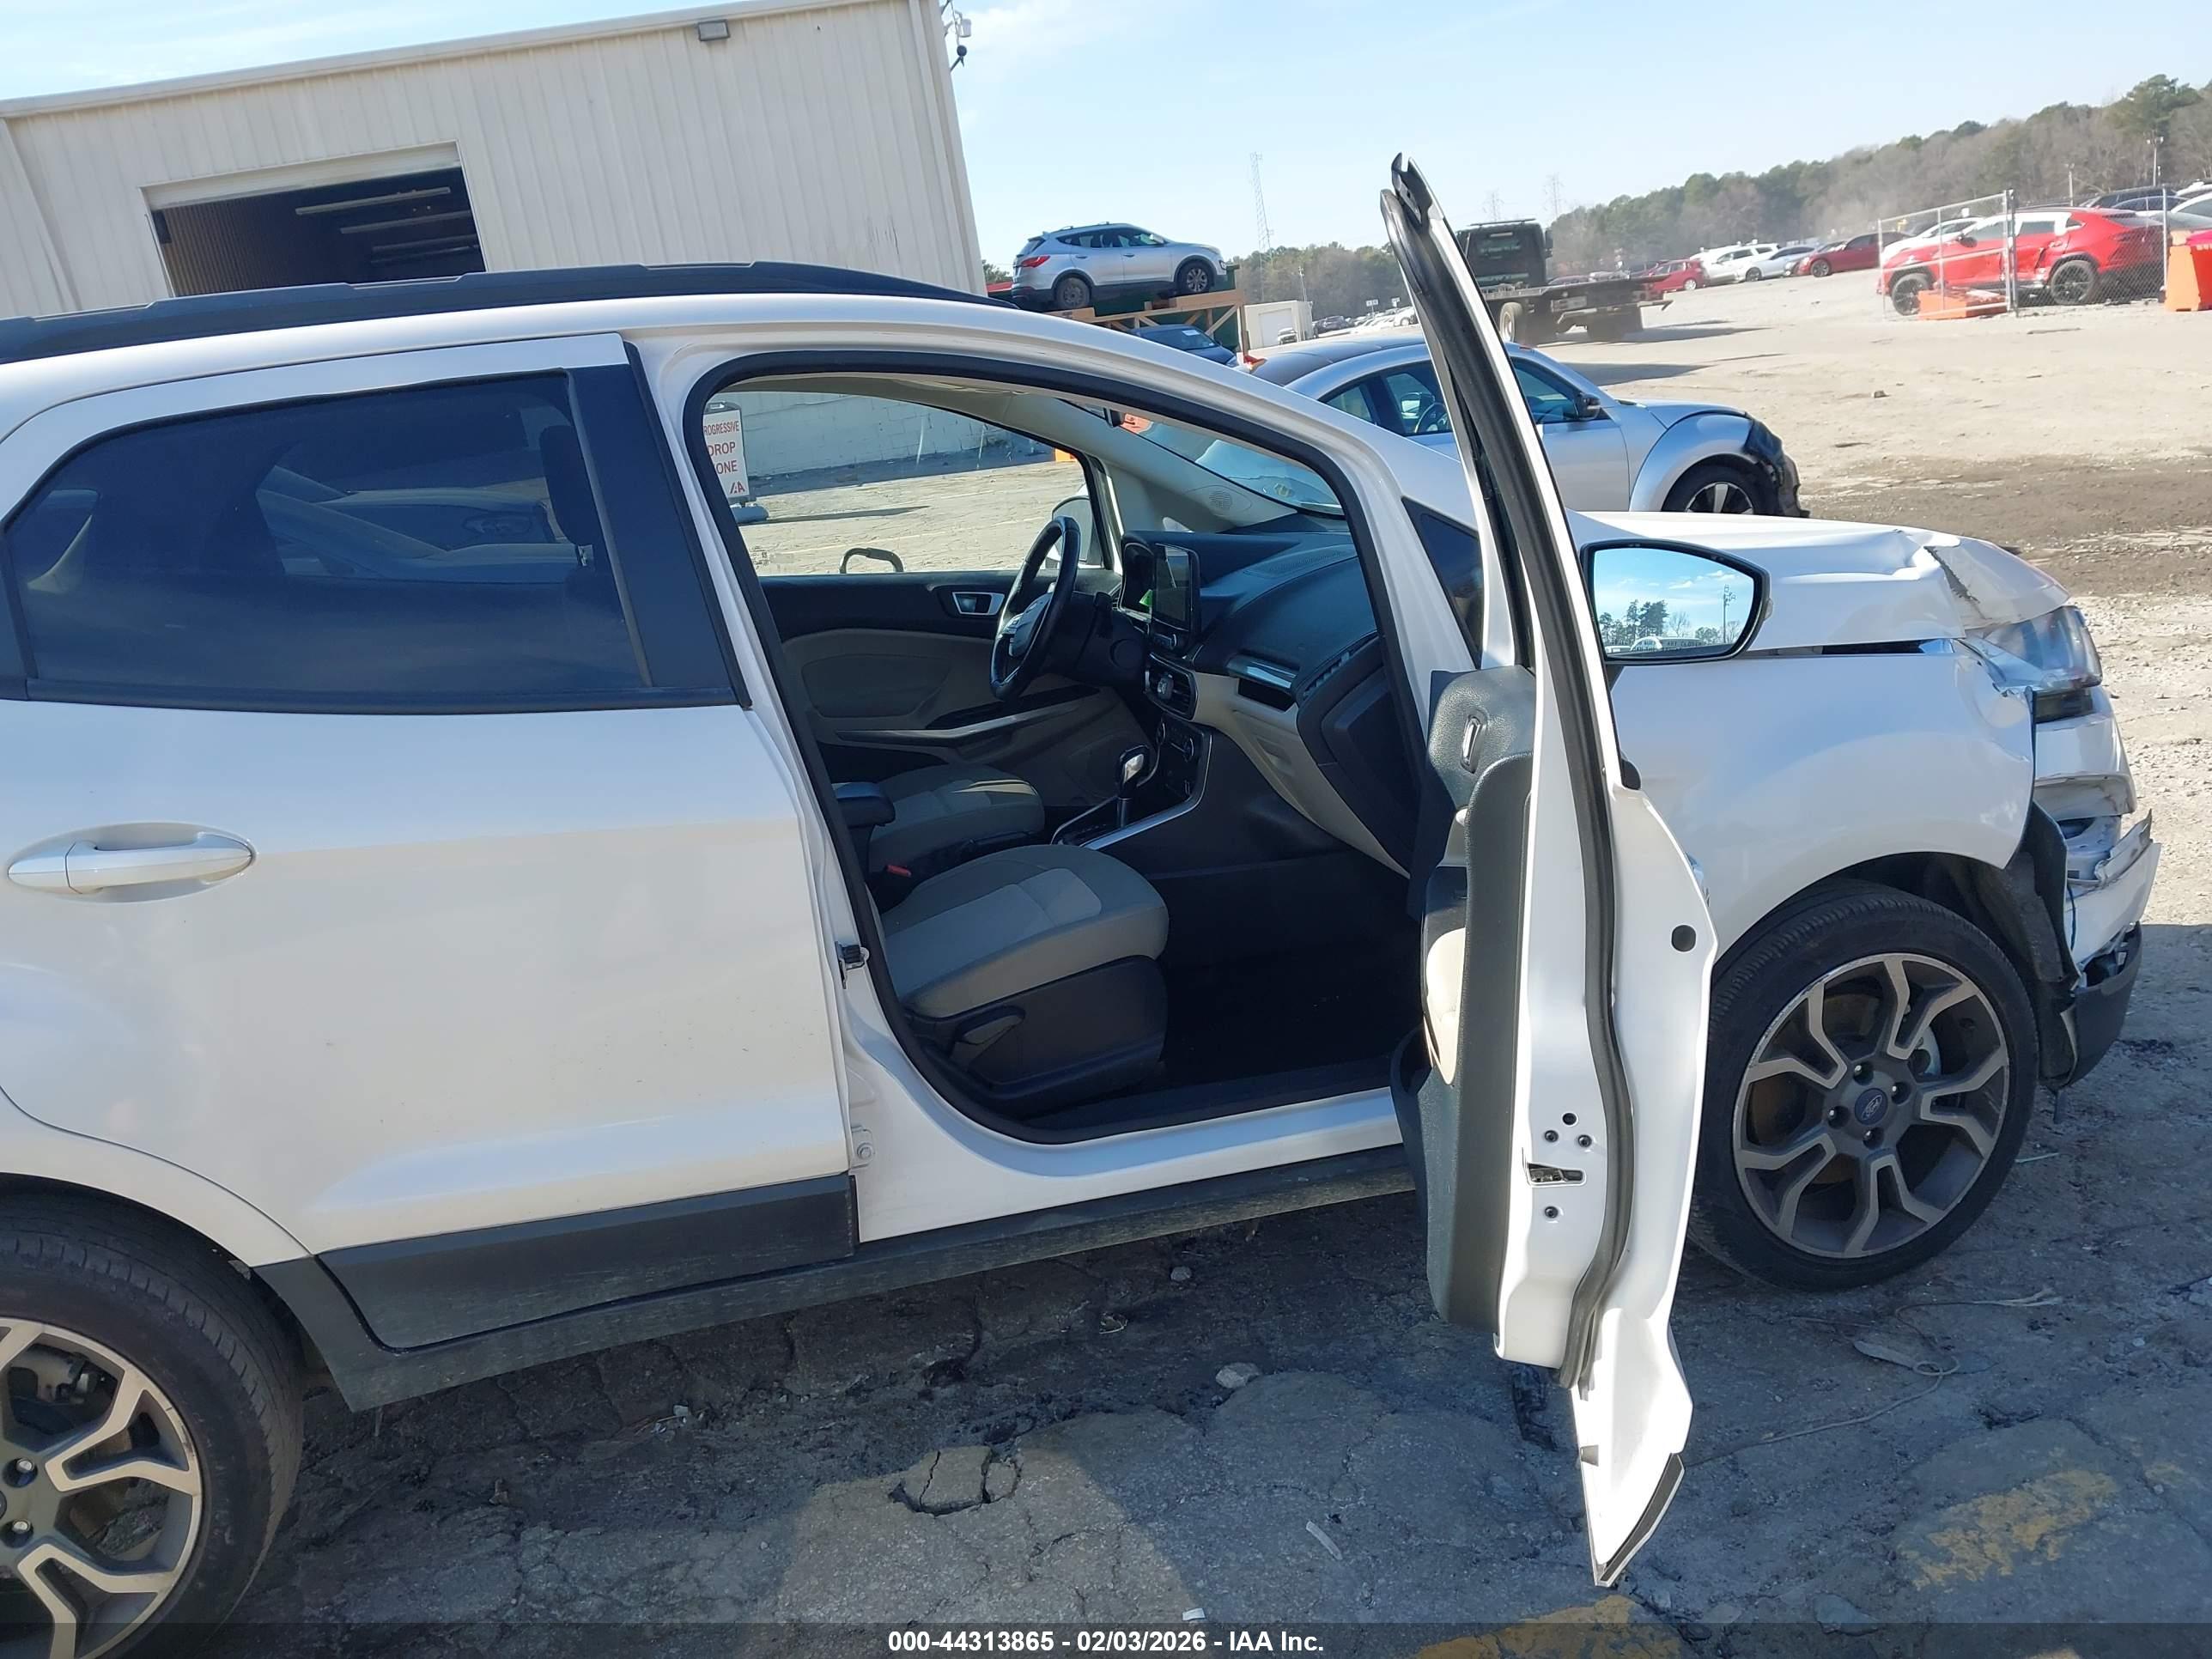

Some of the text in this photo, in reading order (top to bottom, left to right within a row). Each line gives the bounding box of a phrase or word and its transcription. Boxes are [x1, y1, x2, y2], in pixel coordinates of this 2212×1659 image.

[703, 421, 739, 436] ROGRESSIVE
[707, 441, 736, 457] DROP
[715, 459, 738, 475] ONE
